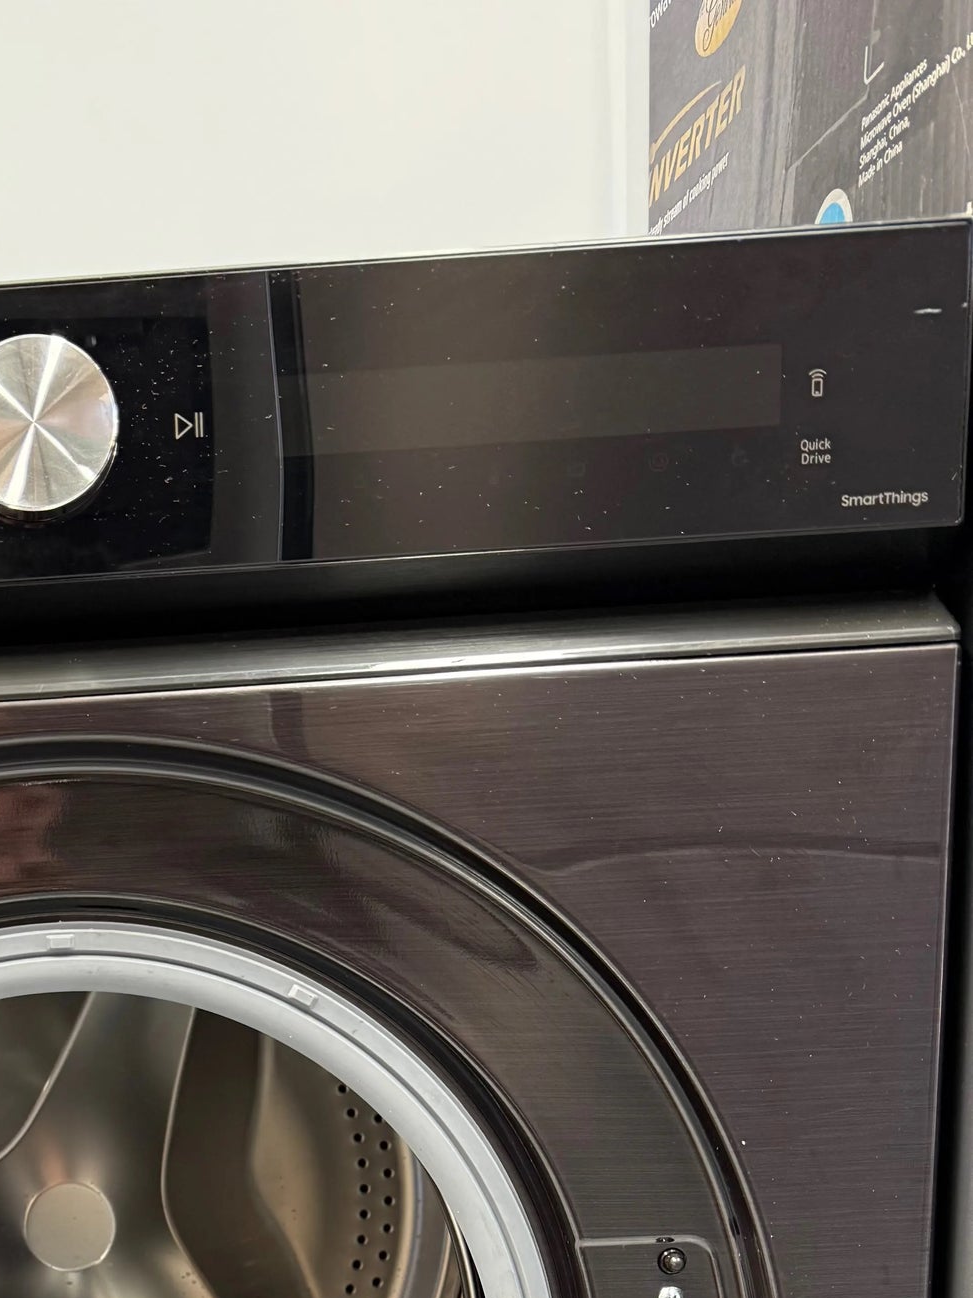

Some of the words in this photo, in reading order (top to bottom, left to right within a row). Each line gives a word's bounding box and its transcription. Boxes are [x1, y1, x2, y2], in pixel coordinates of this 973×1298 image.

[860, 111, 892, 151] Microwave
[892, 92, 912, 117] Oven
[912, 54, 951, 103] (Shanghai)
[861, 93, 890, 131] Panasonic
[890, 58, 927, 99] Appliances
[648, 64, 746, 209] NVERTER
[859, 132, 888, 170] Shanghai,
[888, 116, 911, 140] China,
[689, 171, 711, 203] cooking
[710, 152, 729, 186] power
[858, 164, 876, 188] Made
[876, 159, 883, 173] in
[883, 141, 903, 164] China
[800, 438, 831, 452] Quick
[801, 453, 831, 465] Drive
[841, 490, 929, 507] SmartThings
